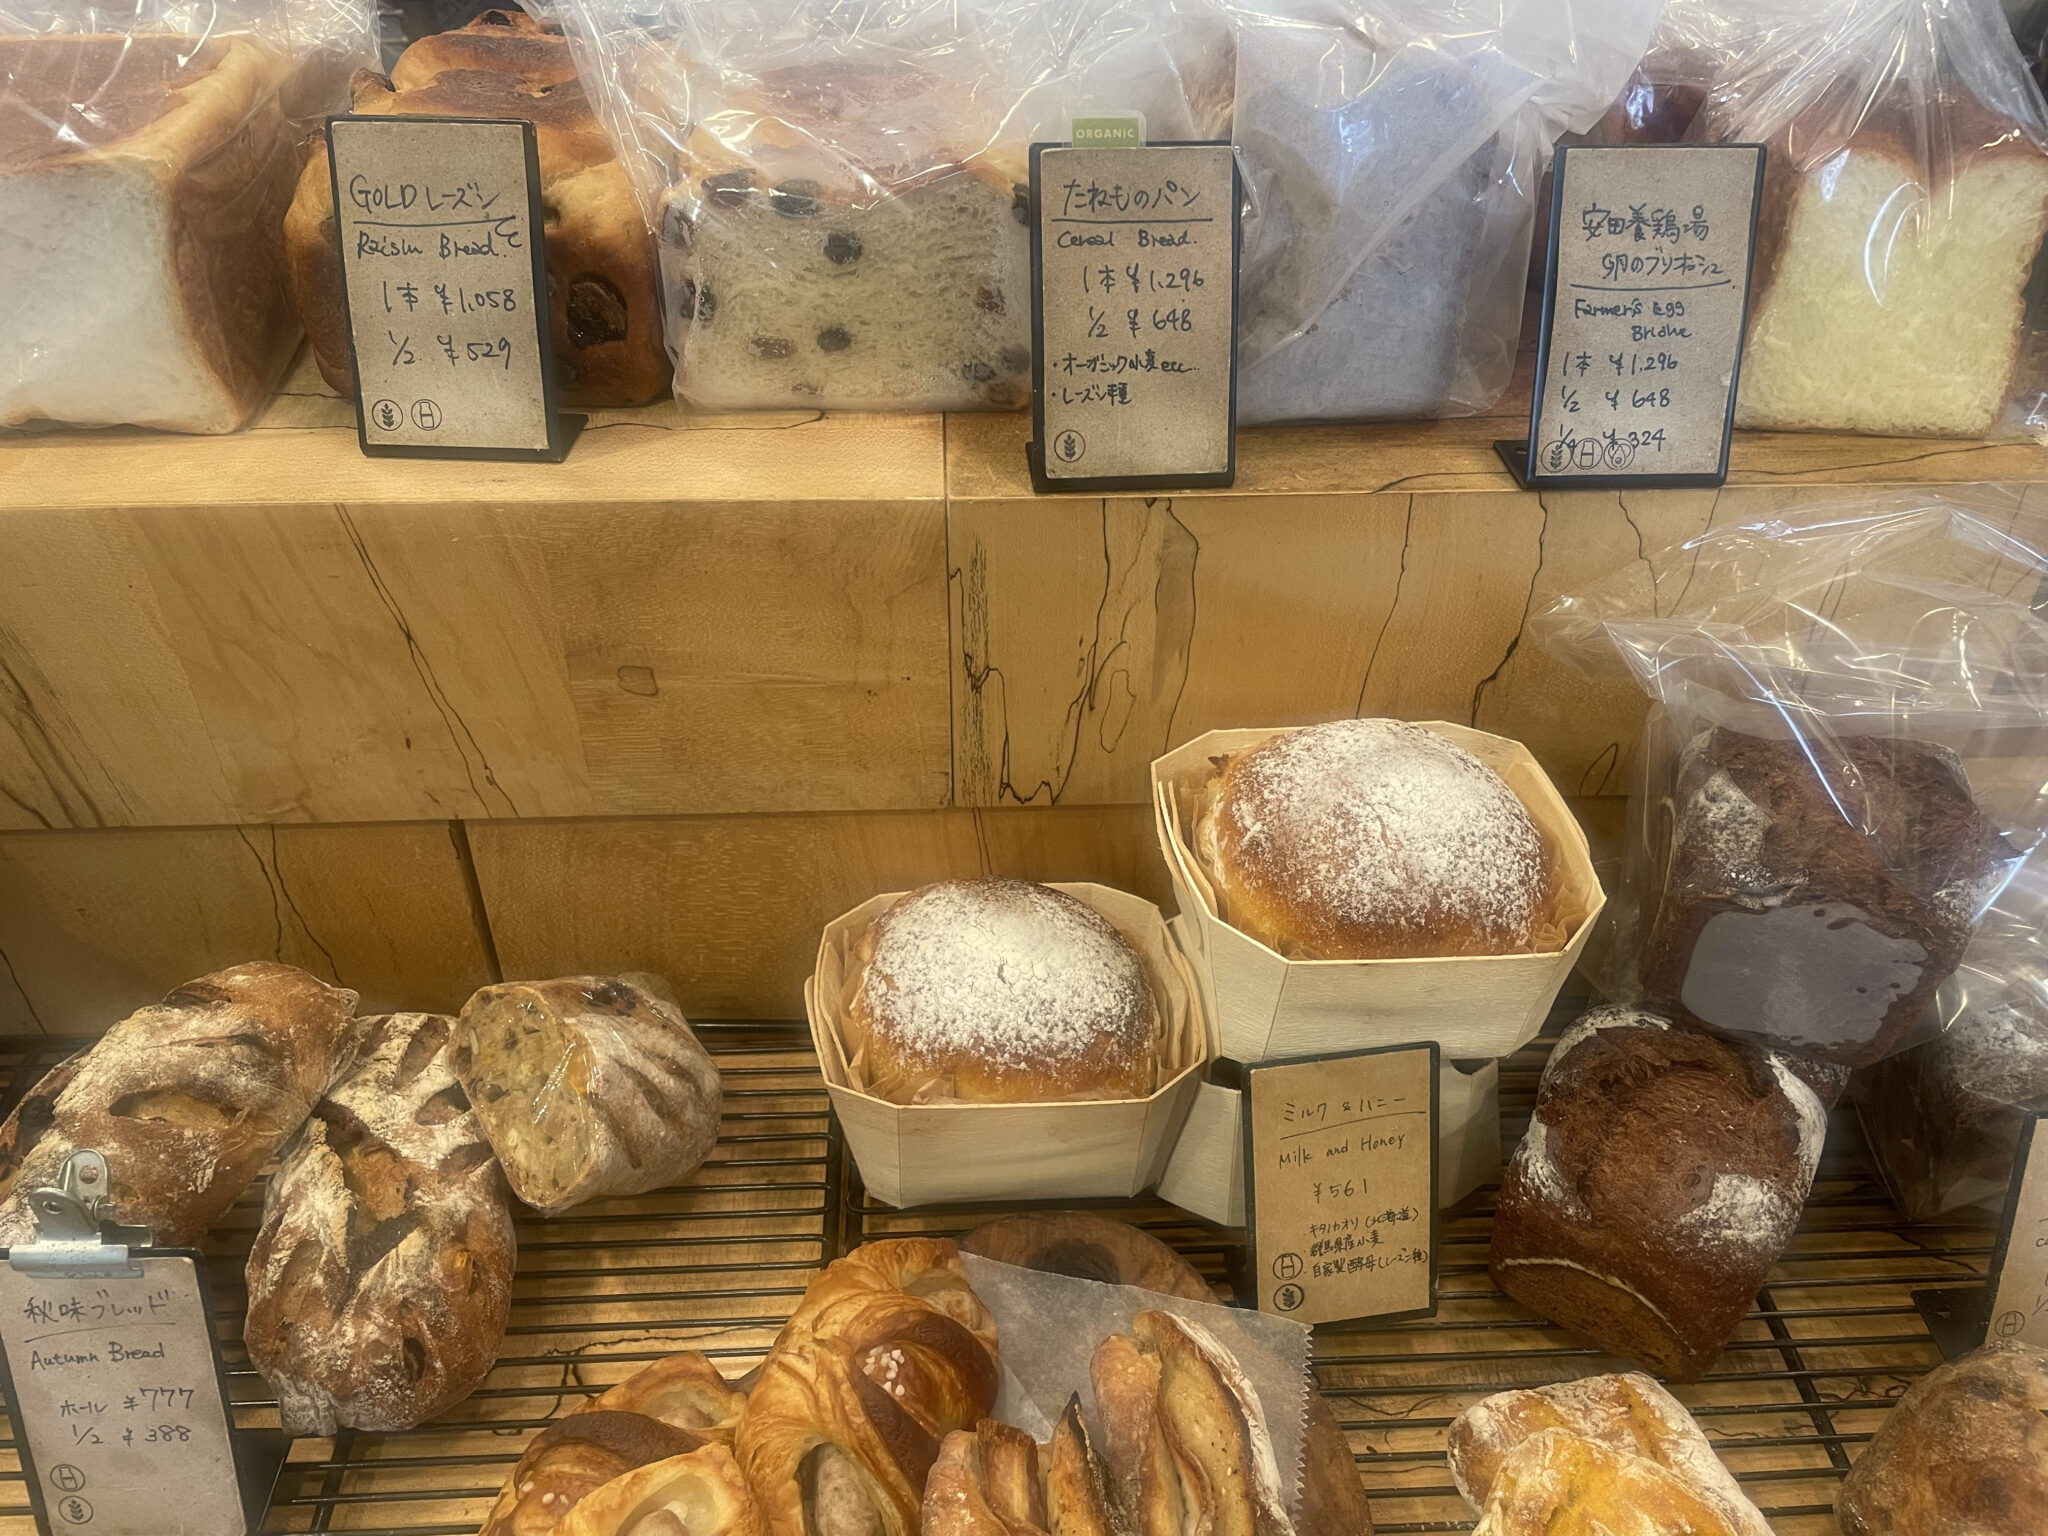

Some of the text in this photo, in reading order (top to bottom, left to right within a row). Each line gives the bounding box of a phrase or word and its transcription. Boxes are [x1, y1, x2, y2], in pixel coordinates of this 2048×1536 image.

[1074, 127, 1136, 140] ORGANIC
[349, 174, 501, 215] GOLD レーズン
[1062, 178, 1201, 216] たねものパン
[1581, 201, 1710, 245] 安田養鶏場
[1652, 300, 1685, 319] Egg
[1283, 1102, 1327, 1122] ミルク
[1279, 1133, 1406, 1170] Milk and Honey
[22, 1288, 173, 1326] 秋味ブレッド
[30, 1341, 165, 1371] Autumn Bread
[60, 1399, 108, 1418] ホール
